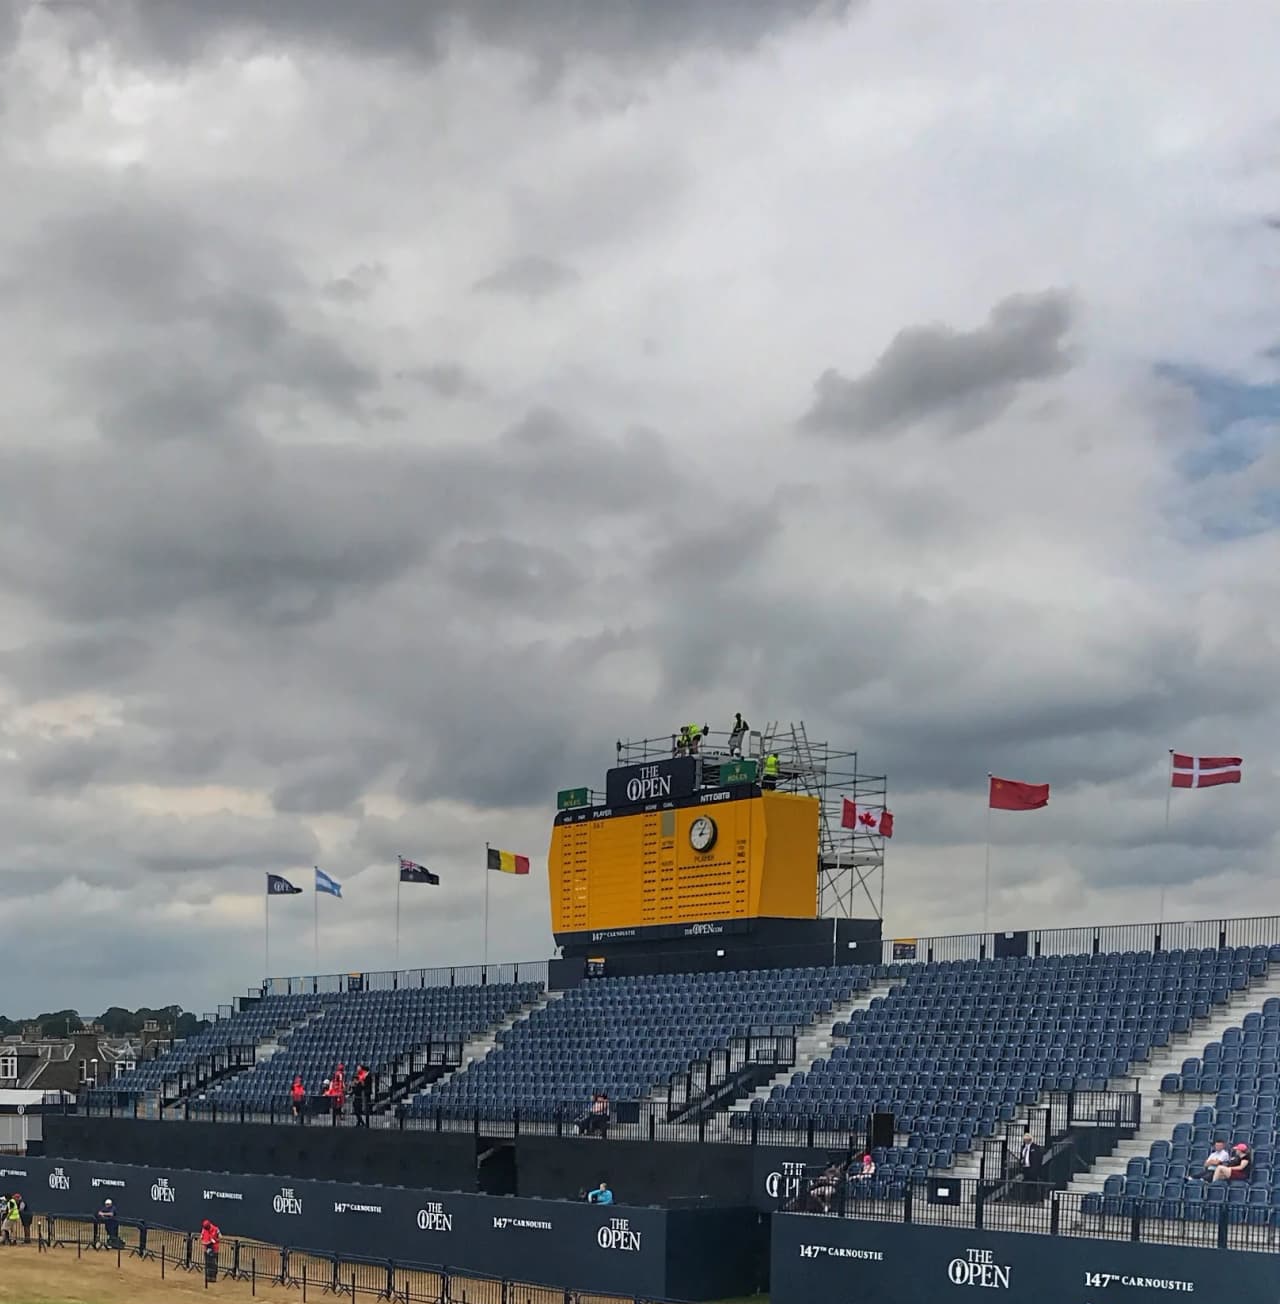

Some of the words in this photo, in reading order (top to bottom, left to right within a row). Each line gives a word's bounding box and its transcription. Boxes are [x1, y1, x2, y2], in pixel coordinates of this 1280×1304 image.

[640, 765, 659, 778] THE
[627, 775, 672, 801] OPEN
[593, 809, 612, 818] PLAYER
[55, 1168, 64, 1176] THE
[49, 1174, 70, 1190] OPEN
[158, 1178, 168, 1187] THE
[151, 1184, 175, 1202] OPEN
[281, 1188, 294, 1198] THE
[273, 1195, 302, 1214] OPEN
[350, 1204, 382, 1213] CARNOUSTIE
[427, 1202, 443, 1213] THE
[417, 1210, 453, 1232] OPEN
[513, 1219, 552, 1230] CARNOUSTIE
[610, 1218, 629, 1231] THE
[597, 1226, 641, 1251] OPEN
[827, 1247, 884, 1261] CARNOUSTIE
[966, 1248, 993, 1264] THE
[947, 1258, 1012, 1289] OPEN
[1121, 1275, 1194, 1292] CARNOUSTIE
